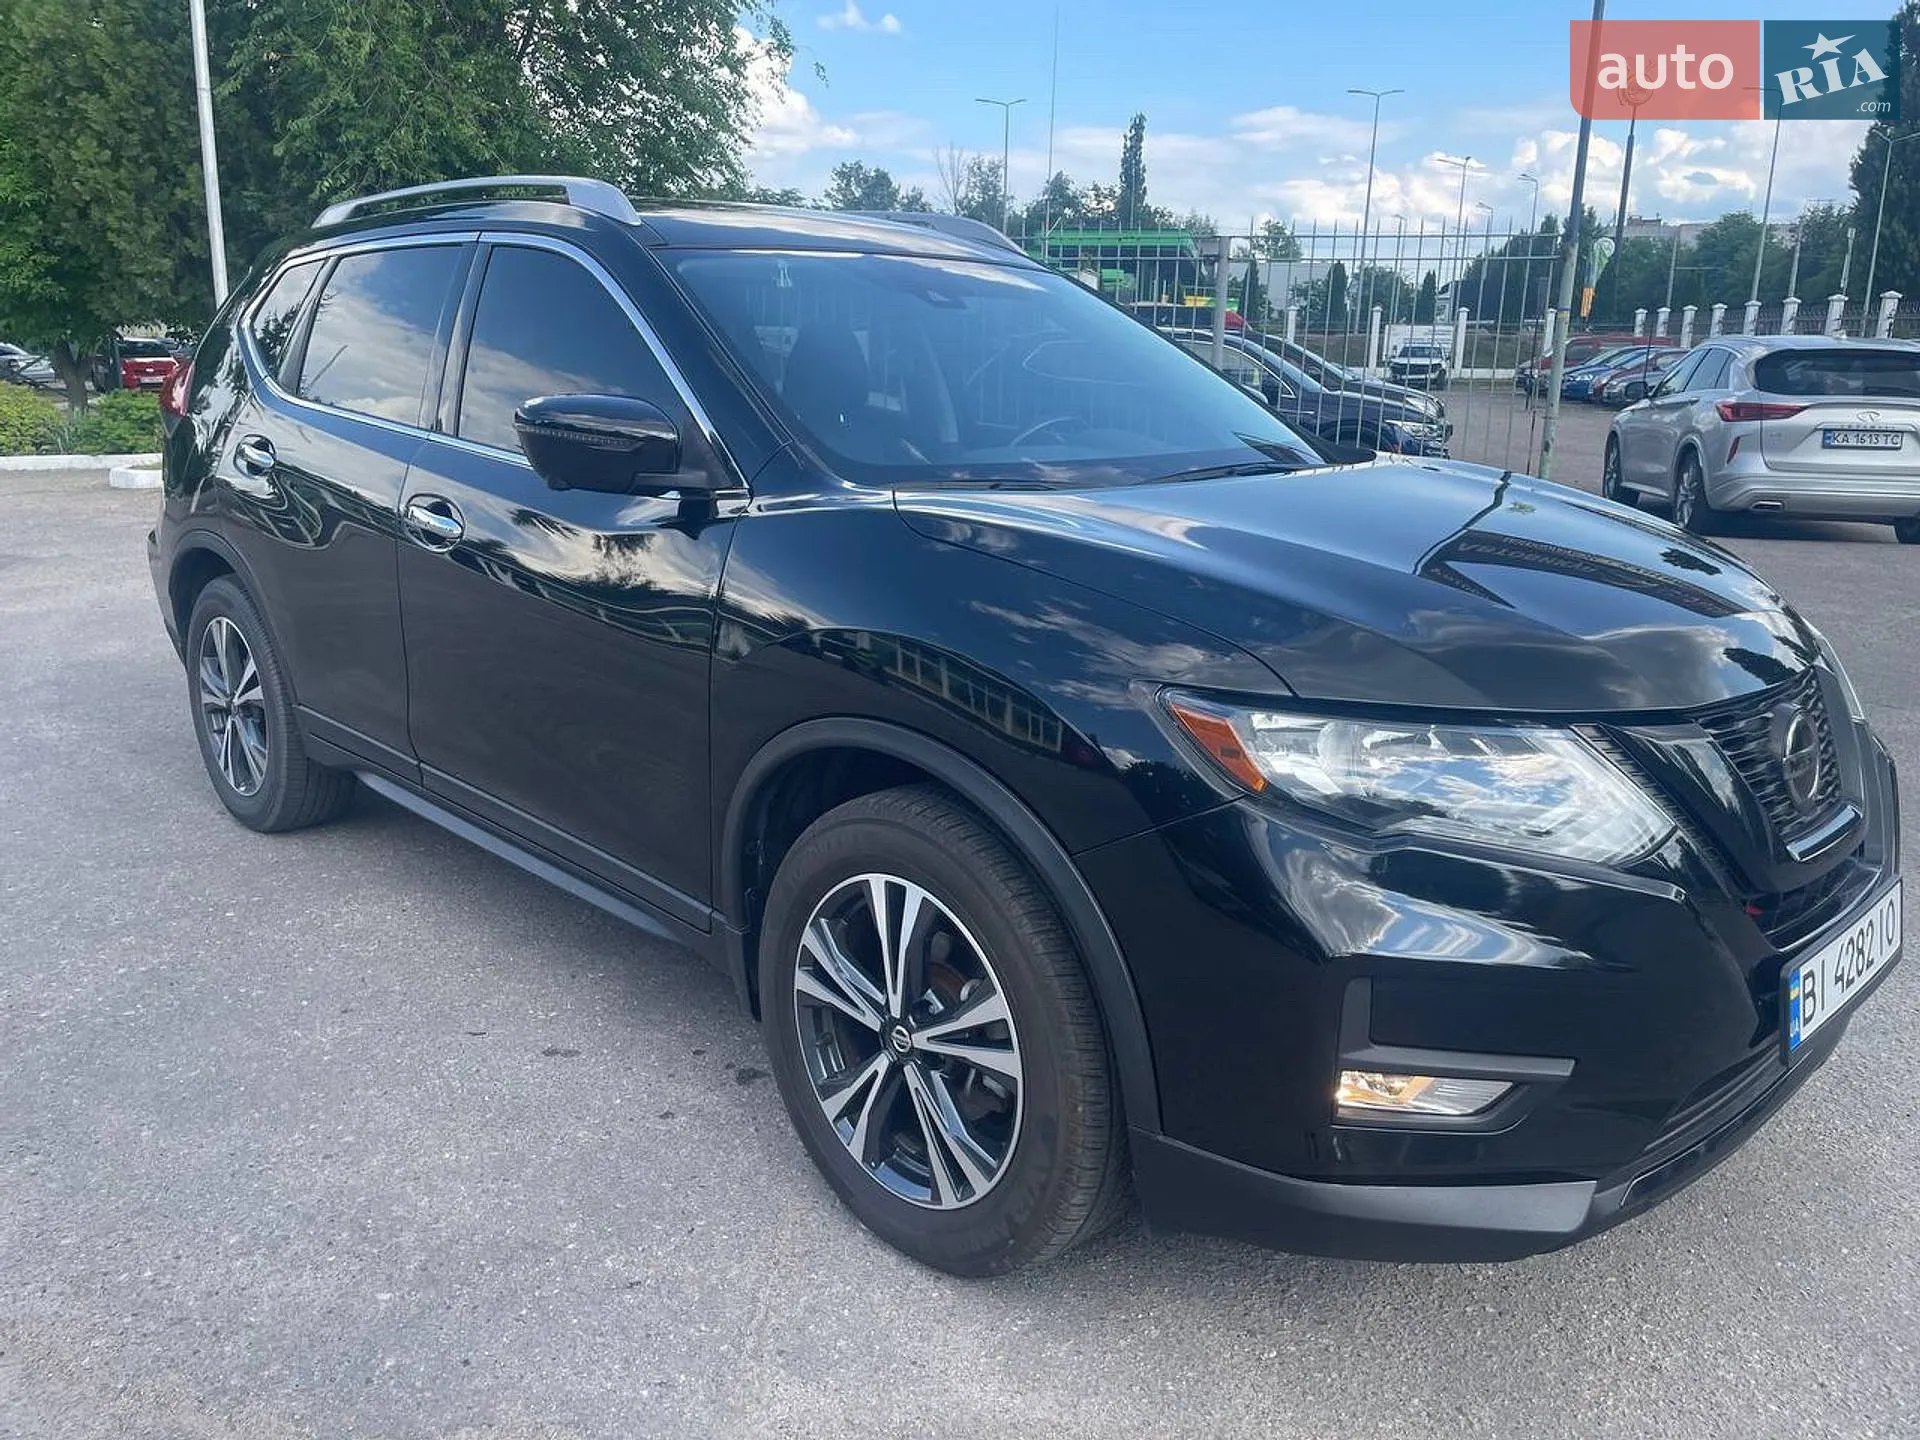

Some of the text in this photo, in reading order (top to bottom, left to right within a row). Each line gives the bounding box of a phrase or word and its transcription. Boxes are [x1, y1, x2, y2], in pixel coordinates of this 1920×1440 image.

[1832, 432, 1900, 445] KA 1613 TC
[1802, 898, 1896, 1028] BI 4282 IO
